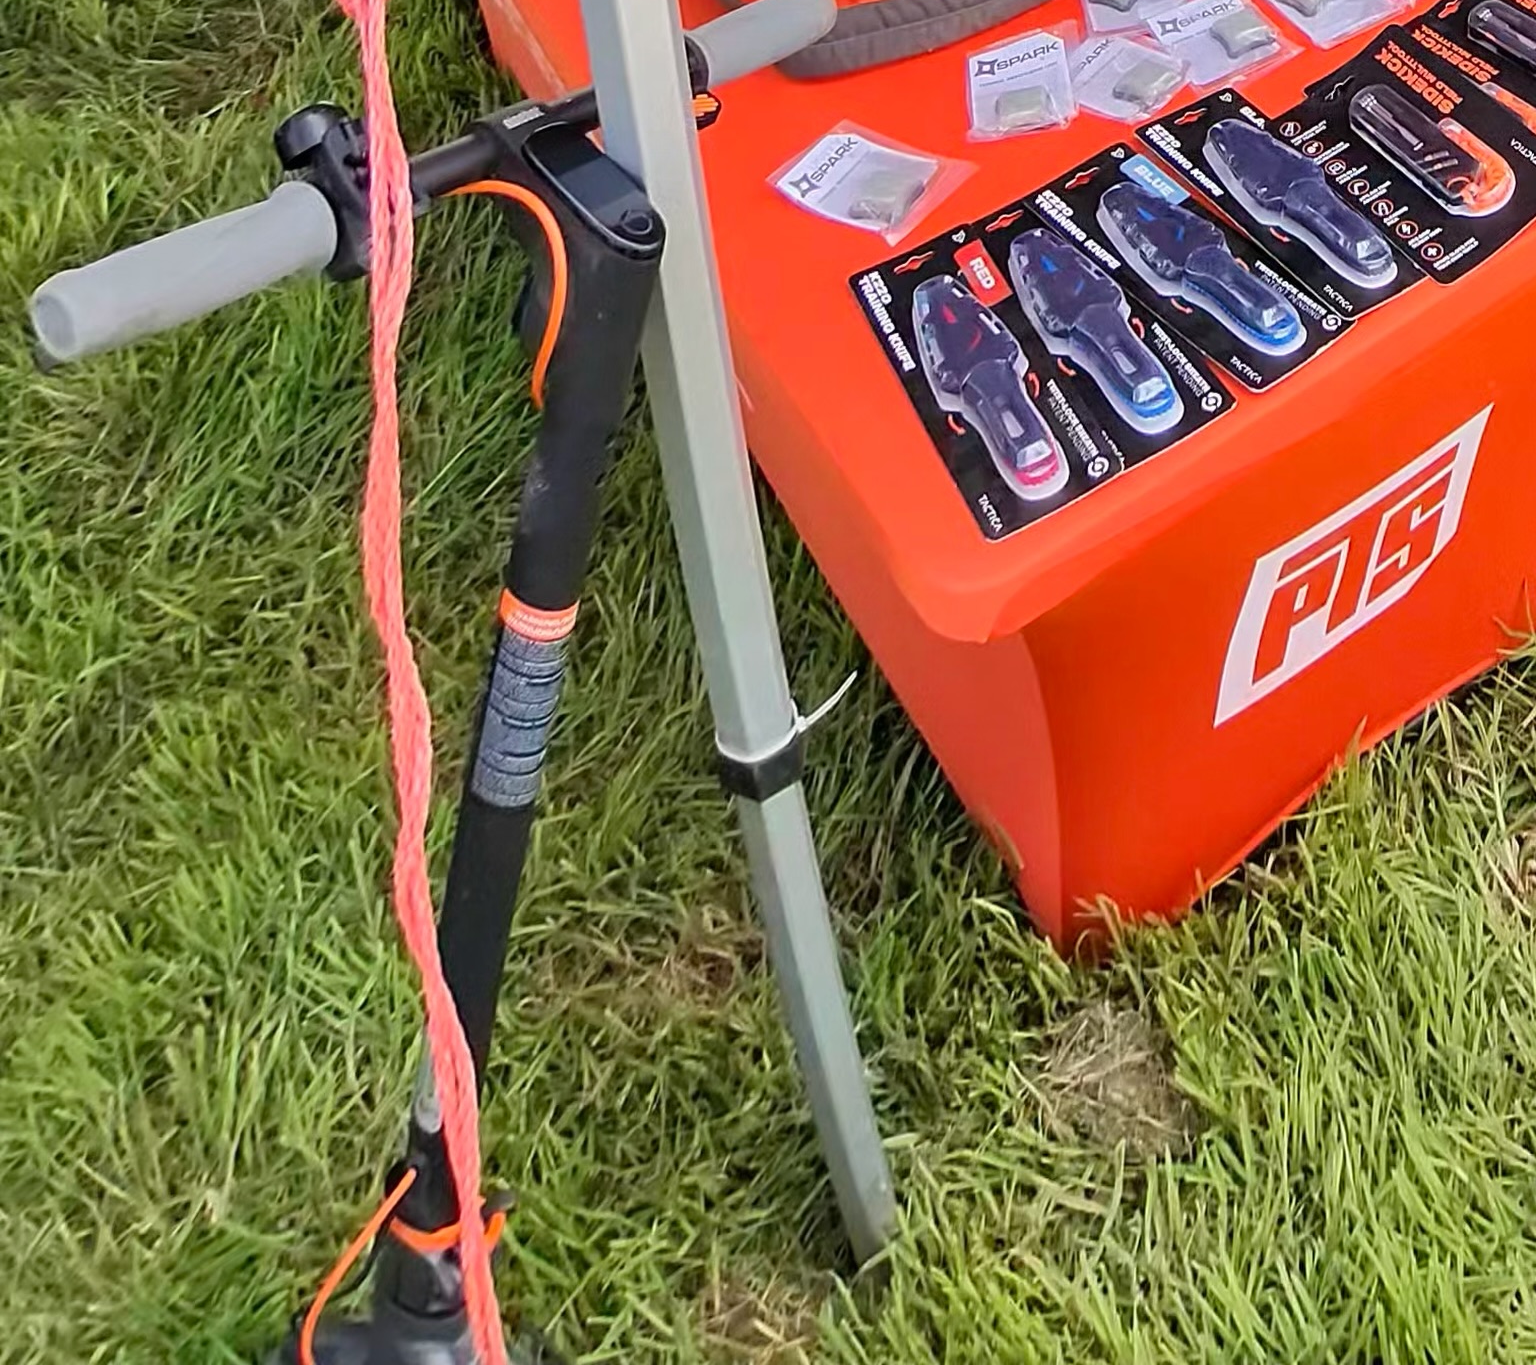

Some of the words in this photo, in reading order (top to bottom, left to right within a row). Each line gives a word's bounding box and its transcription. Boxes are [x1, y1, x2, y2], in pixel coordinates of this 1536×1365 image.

[1178, 0, 1237, 29] SPARK
[996, 40, 1059, 72] SPARK
[1411, 27, 1493, 84] SIDEKICK
[1421, 24, 1468, 59] MULTITOOL
[1388, 40, 1438, 85] MULTITOOL
[1467, 56, 1500, 77] FIELD
[1374, 46, 1457, 115] SIDEKICK
[1436, 81, 1465, 106] FIELD
[1150, 123, 1182, 149] K220
[810, 136, 858, 183] SPARK
[1145, 127, 1194, 171] TRAINING
[1190, 166, 1225, 198] KNIFE
[1133, 163, 1176, 197] BLUE
[1041, 189, 1075, 218] K220
[1034, 194, 1087, 244] TRAINING
[1083, 236, 1122, 271] KNIFE
[867, 270, 892, 305] K220
[968, 256, 996, 290] RED
[1253, 259, 1301, 297] TWIST-LOCK
[1296, 289, 1328, 317] SHEATH
[1321, 283, 1354, 313] TACTICA
[858, 274, 895, 336] TRAINING
[887, 332, 917, 373] KNIFE
[1229, 354, 1264, 385] TACTICA
[977, 493, 1004, 532] TACTICA
[1225, 416, 1483, 716] PTS
